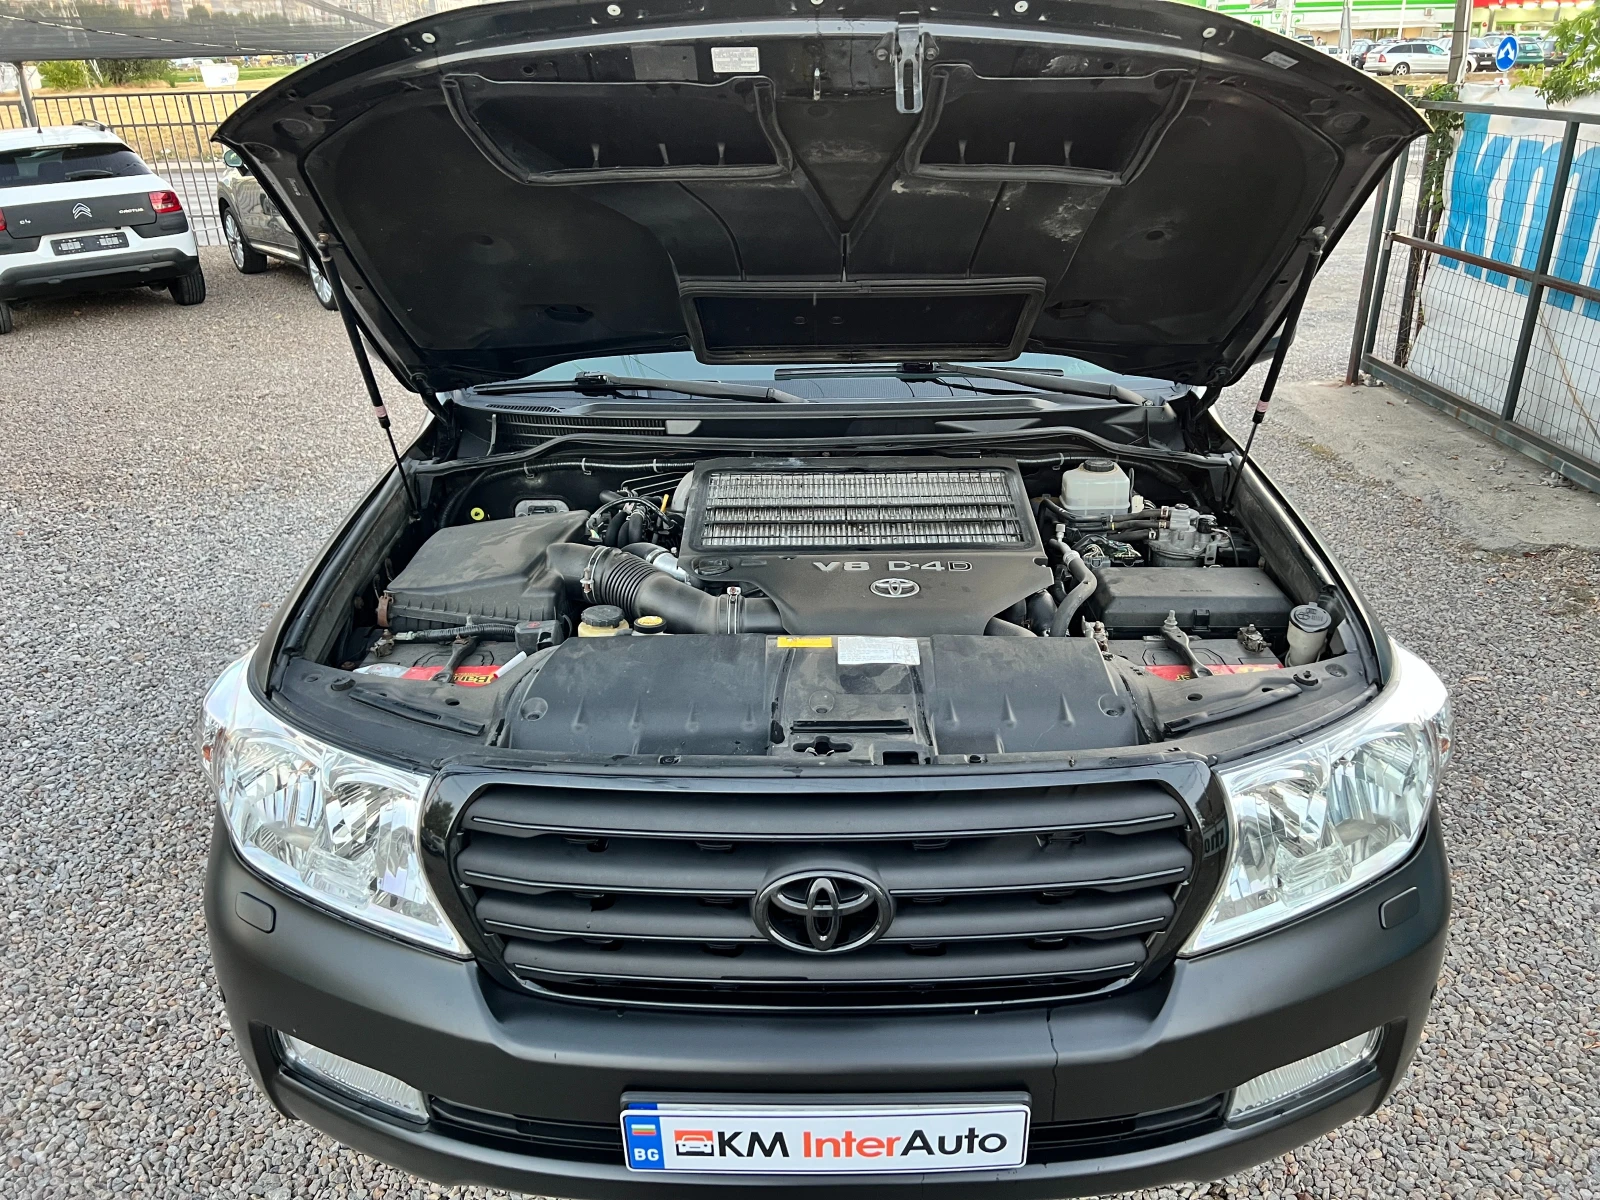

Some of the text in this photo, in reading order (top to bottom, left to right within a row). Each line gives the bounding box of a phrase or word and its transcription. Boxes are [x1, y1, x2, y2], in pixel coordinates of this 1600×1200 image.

[813, 560, 973, 572] V8 D-4D
[718, 1127, 1008, 1158] KM InterAuto
[634, 1147, 660, 1162] BG
